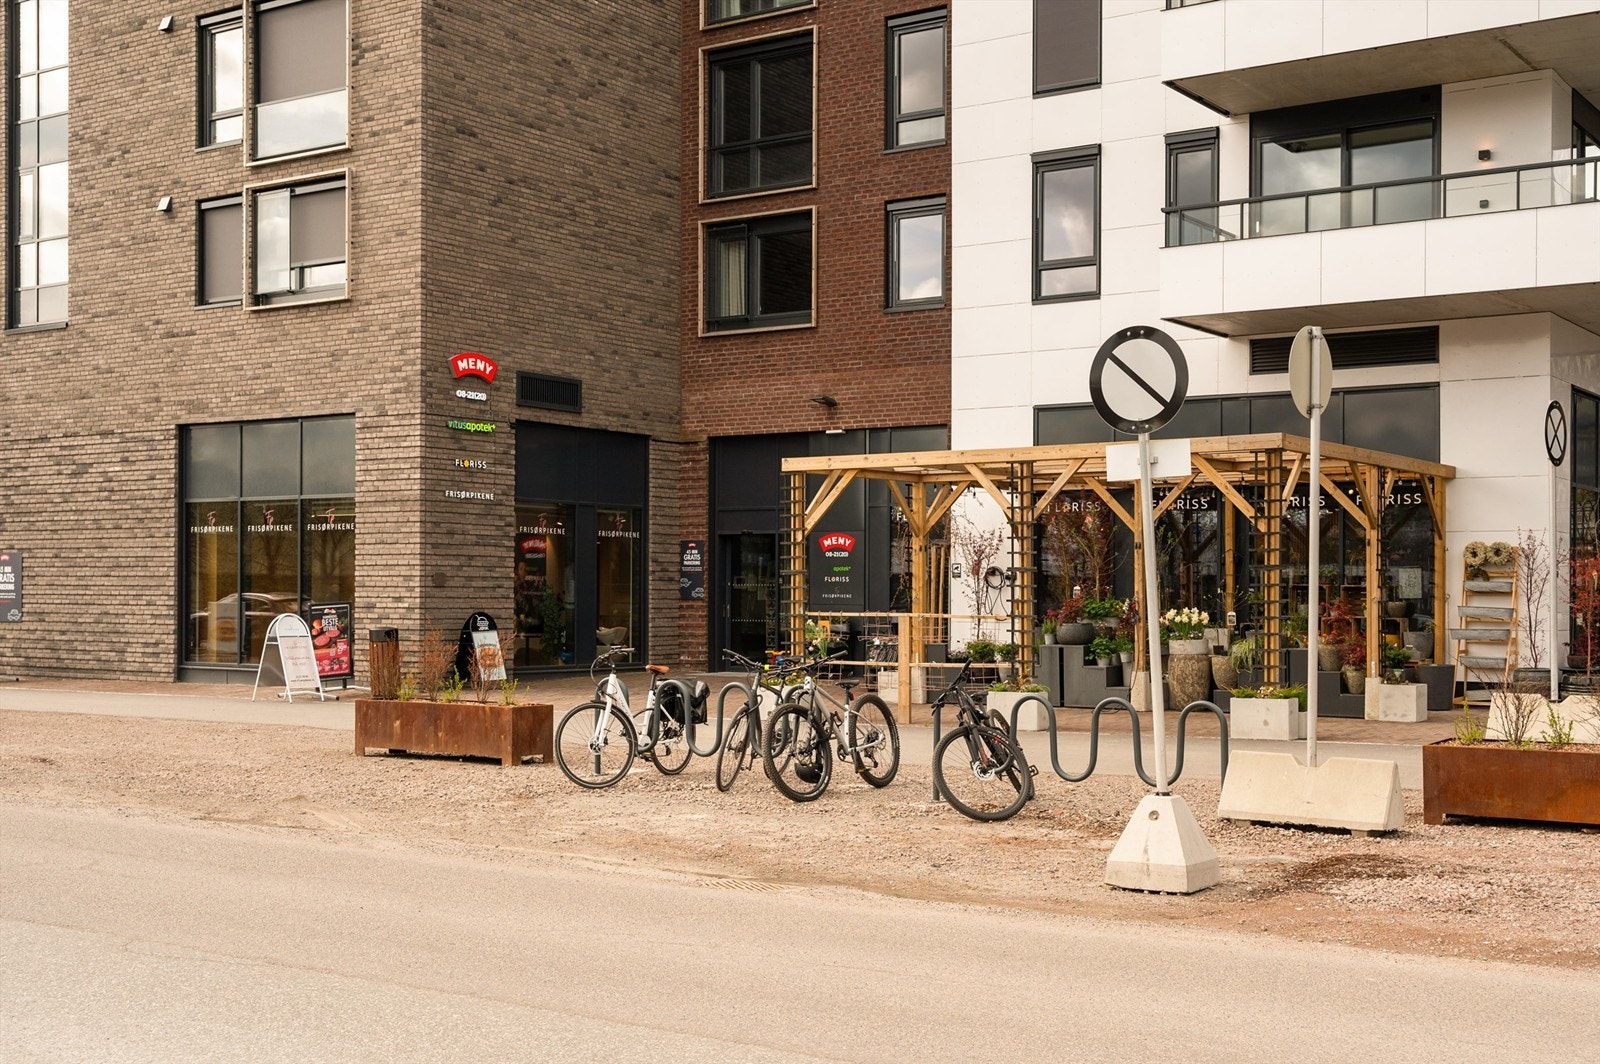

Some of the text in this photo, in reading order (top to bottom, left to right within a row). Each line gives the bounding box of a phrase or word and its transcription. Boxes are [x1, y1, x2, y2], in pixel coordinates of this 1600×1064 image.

[457, 358, 493, 374] MENY
[455, 458, 487, 469] FLORISS
[445, 490, 494, 500] FRISØRPIKENE
[190, 525, 233, 534] FRISØRPIKENE
[308, 523, 354, 531] FRISØRPIKENE
[519, 526, 566, 536] FRISØRPIKENE
[598, 530, 640, 539] FRISØRPIKENE
[823, 536, 851, 547] MENY
[322, 618, 338, 626] BESTE
